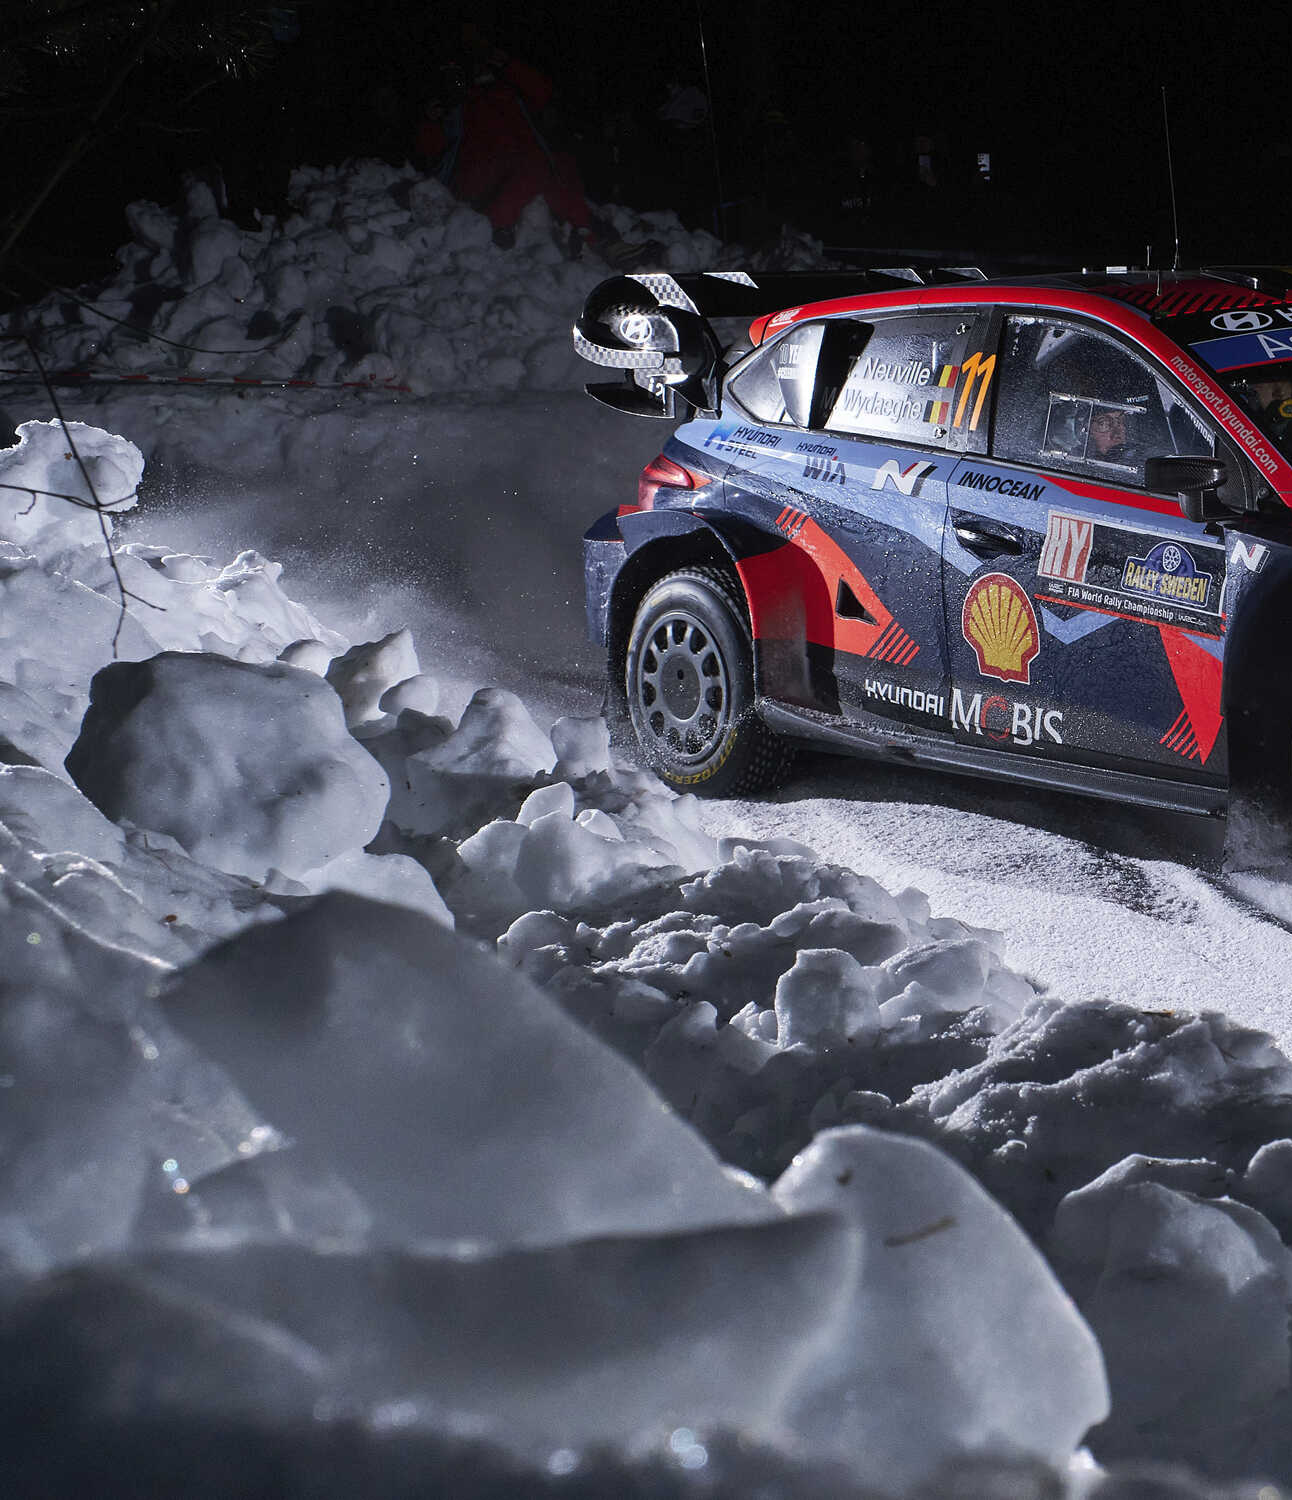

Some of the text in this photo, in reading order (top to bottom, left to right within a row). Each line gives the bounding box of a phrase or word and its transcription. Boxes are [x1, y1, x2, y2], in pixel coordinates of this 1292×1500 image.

[864, 357, 931, 387] Neuville
[844, 388, 923, 423] Wydaeghe
[953, 351, 997, 431] 11
[1170, 355, 1279, 475] motorsport.hyundai.com
[725, 440, 758, 460] STEEL
[734, 426, 783, 448] HYUNDAI
[796, 441, 837, 456] HYUNDAI
[802, 456, 846, 485] WIA
[956, 469, 1046, 502] INNOCEAN
[1124, 562, 1209, 603] RALLY SWEDEN
[1067, 586, 1174, 621] FIA World Rally Championship
[865, 679, 944, 717] HYUNDAI
[951, 687, 1063, 746] MOBIS
